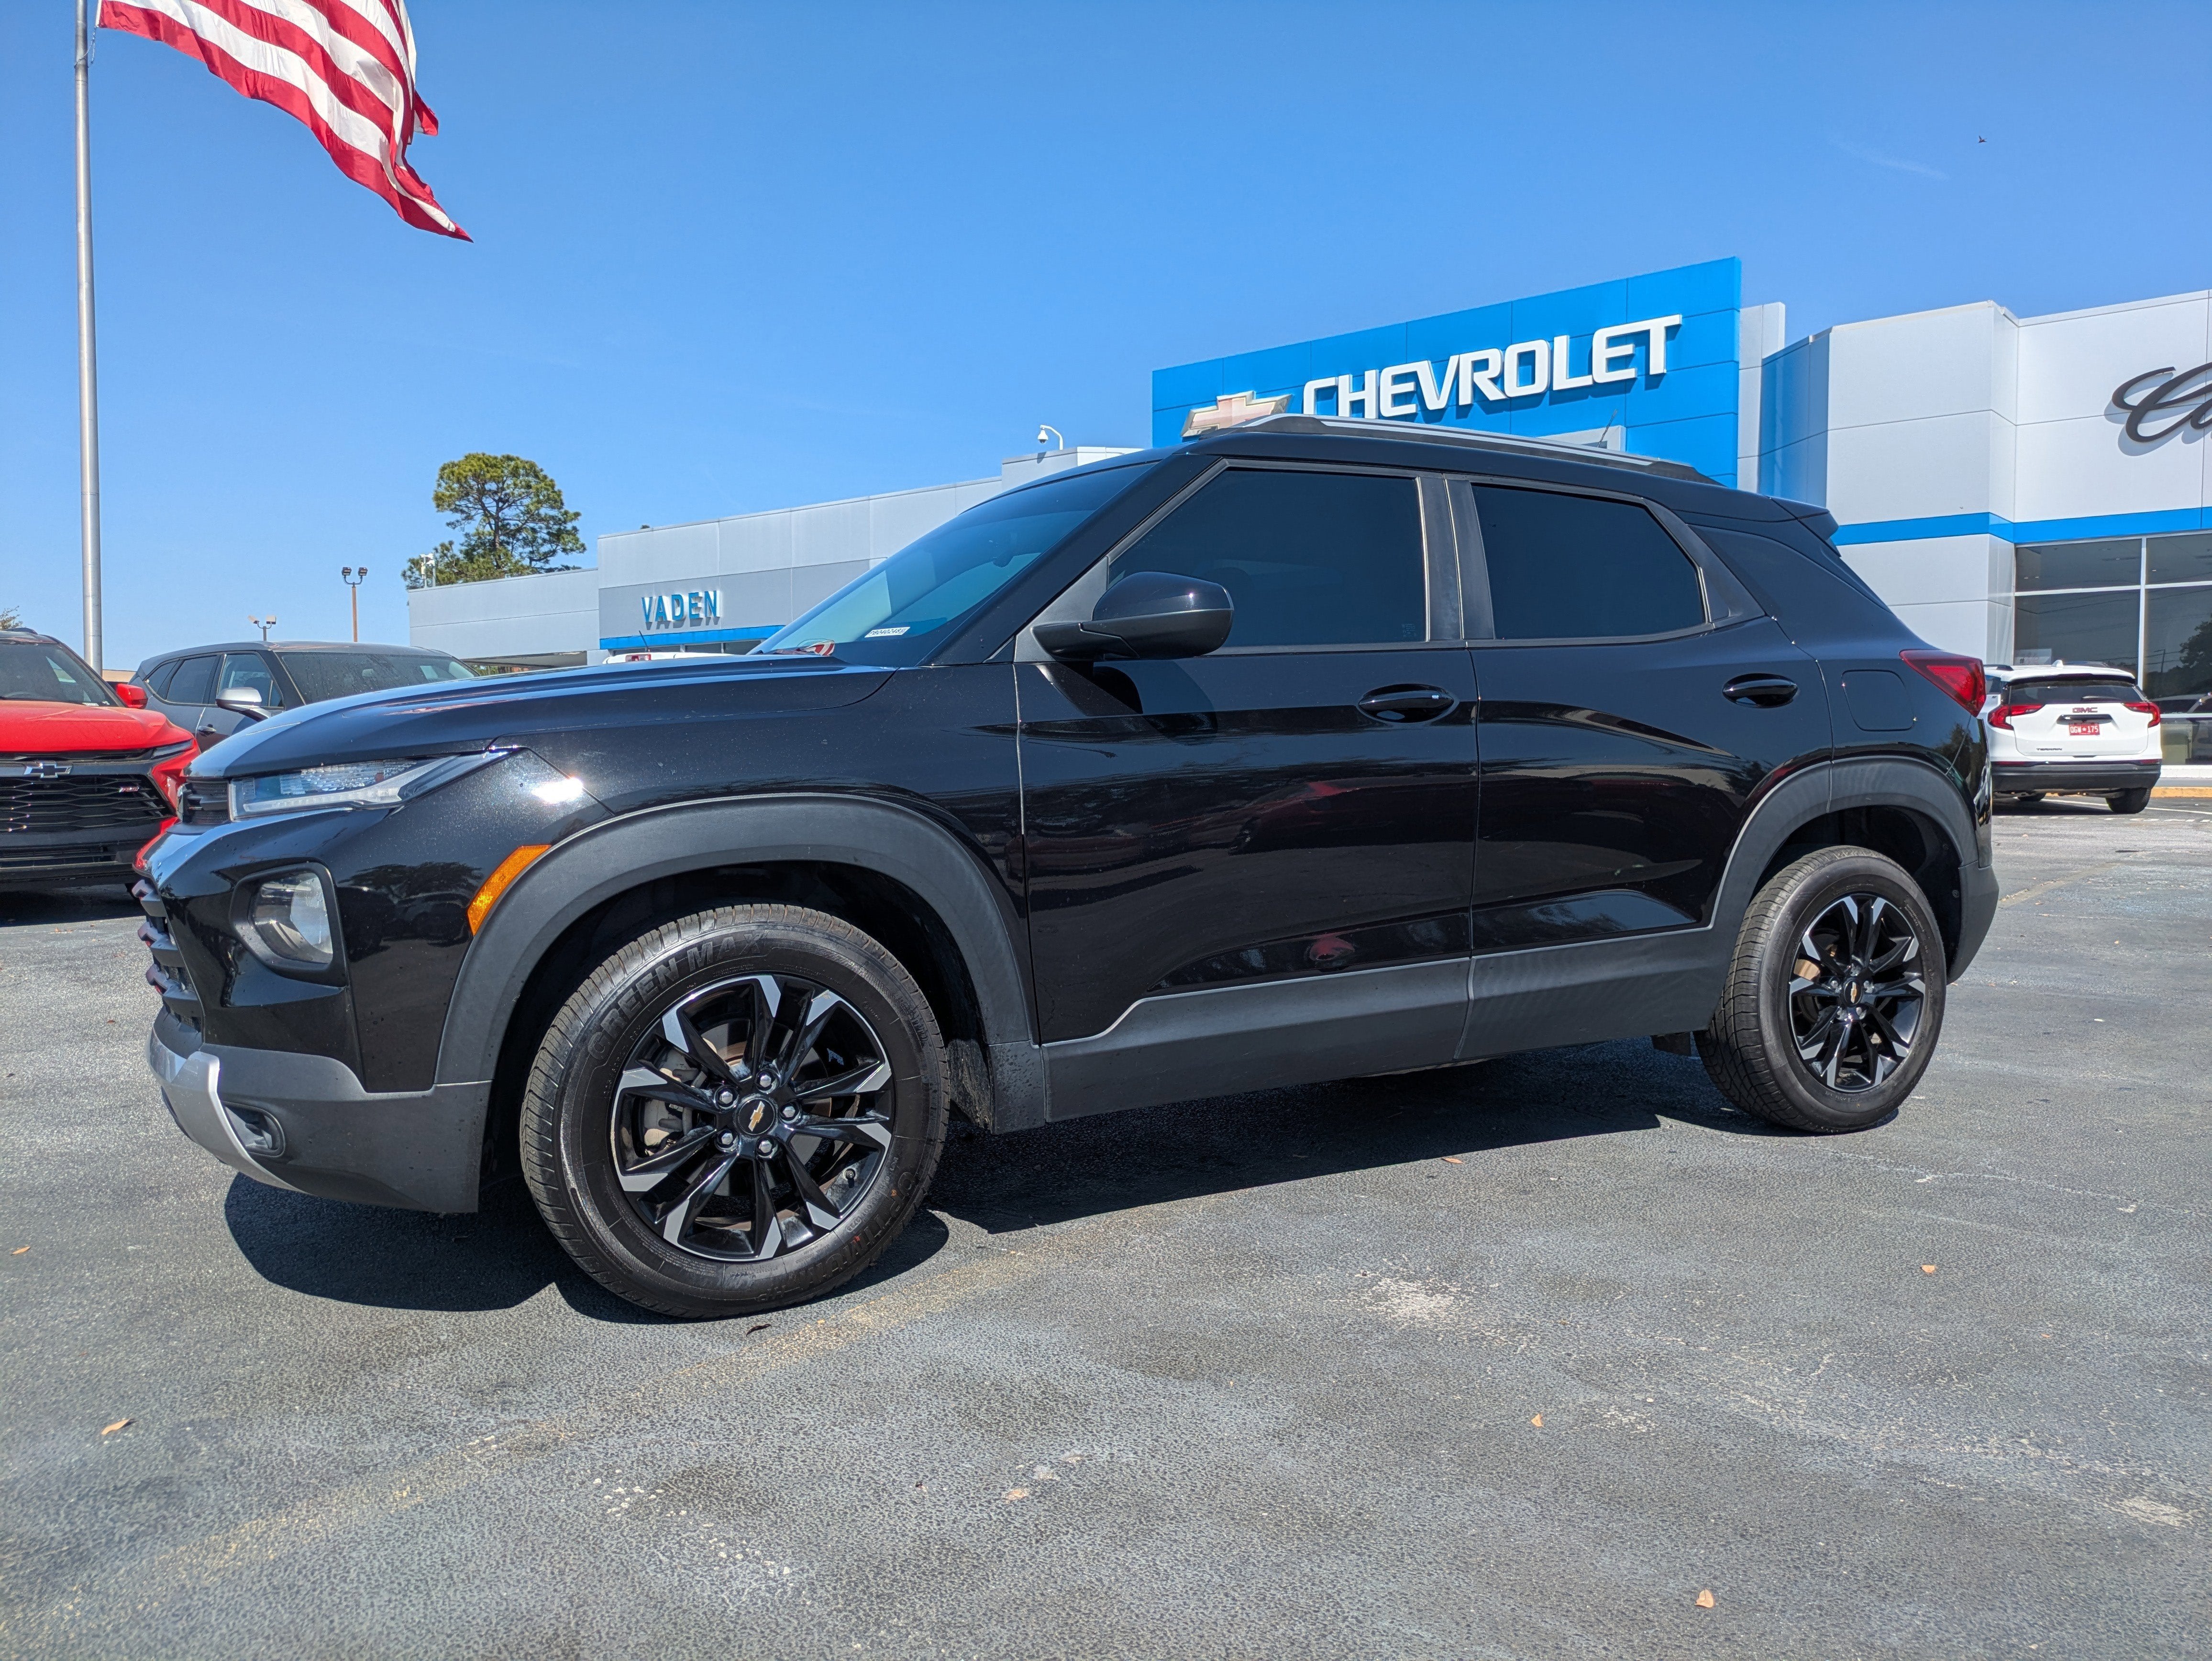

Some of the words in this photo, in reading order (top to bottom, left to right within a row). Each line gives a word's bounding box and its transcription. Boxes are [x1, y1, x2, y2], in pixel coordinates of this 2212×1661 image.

[1303, 314, 1682, 419] CHEVROLET
[641, 590, 719, 622] VADEN
[587, 957, 680, 1060] GREEN
[686, 931, 766, 972] MAX
